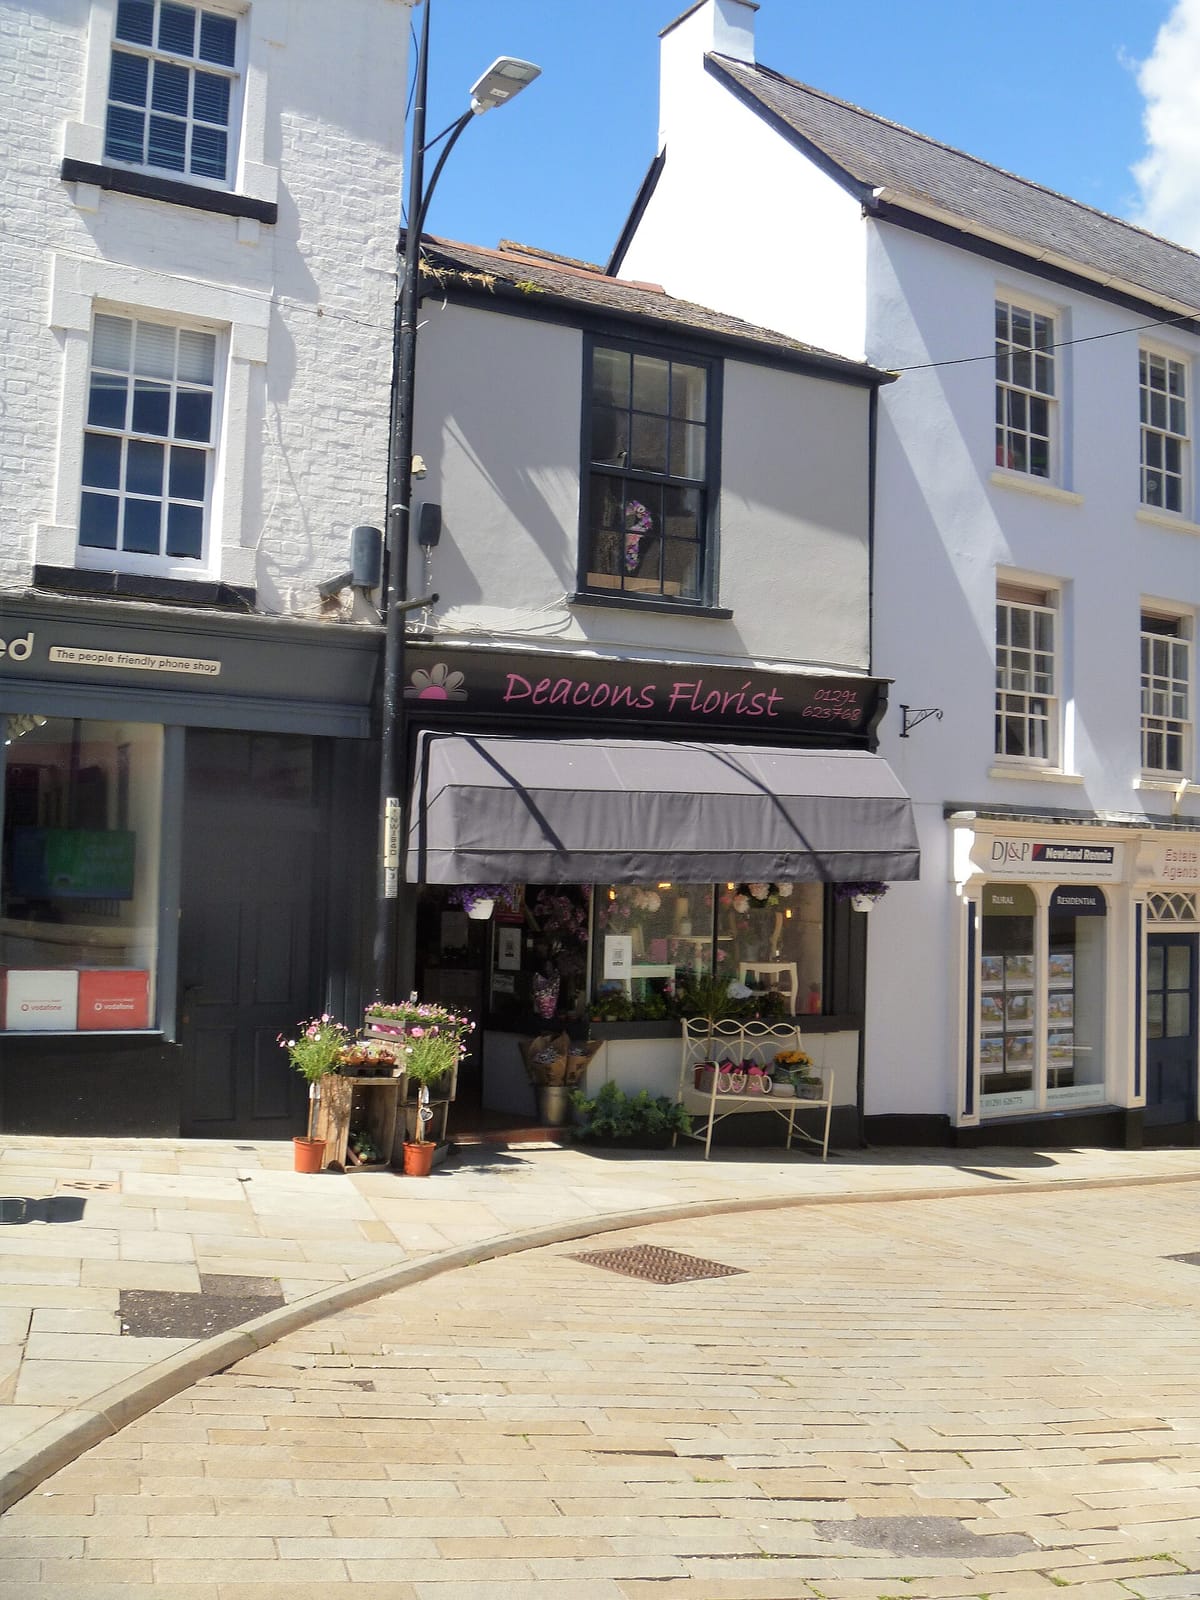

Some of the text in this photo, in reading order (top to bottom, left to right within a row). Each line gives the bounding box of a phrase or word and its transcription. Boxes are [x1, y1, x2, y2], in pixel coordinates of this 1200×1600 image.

[56, 649, 218, 673] The people friendly phone shop
[503, 673, 784, 717] Deacons Florist
[814, 689, 857, 706] 01291
[801, 705, 862, 721] 623768
[991, 841, 1112, 865] DJ&P Newland Rennie
[1165, 848, 1198, 863] Estate
[1161, 865, 1198, 881] Agents
[1056, 896, 1097, 906] RESIDENTIAL
